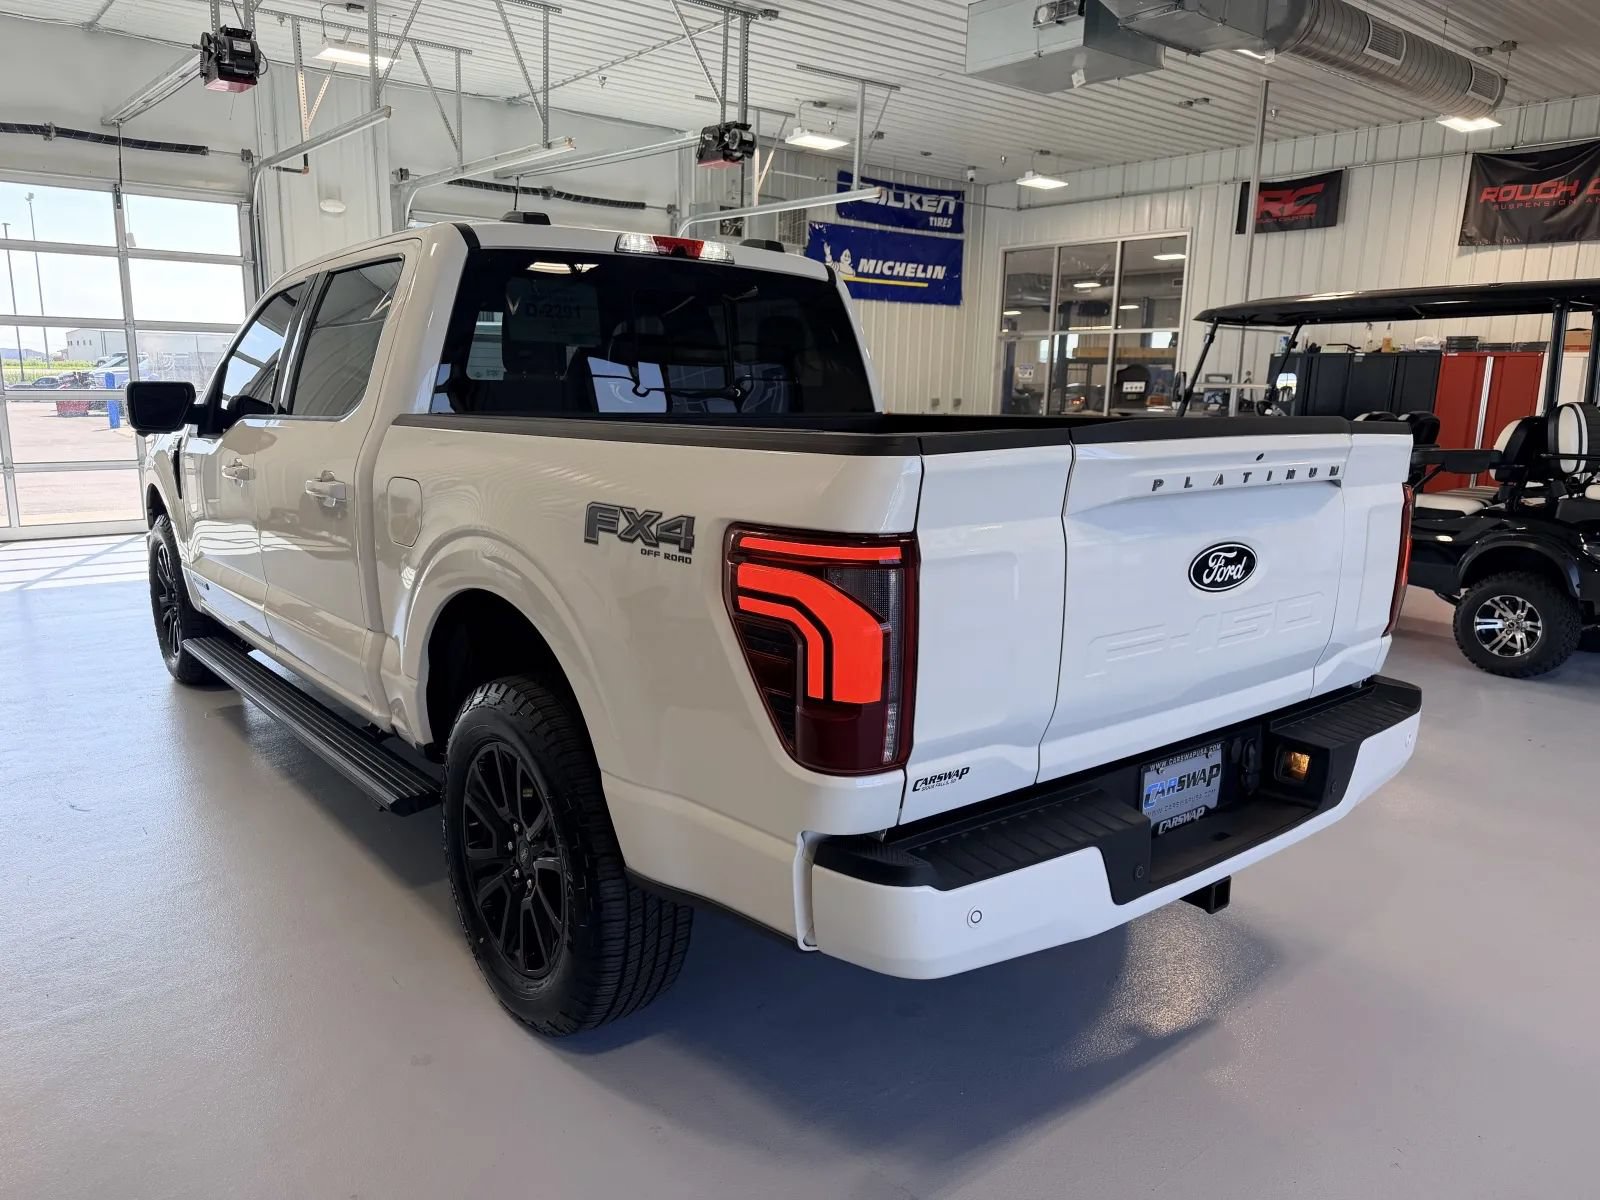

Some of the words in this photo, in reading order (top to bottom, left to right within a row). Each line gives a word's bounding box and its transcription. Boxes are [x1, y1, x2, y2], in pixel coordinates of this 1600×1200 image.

[1256, 183, 1325, 218] RC
[1479, 179, 1580, 203] ROUGH
[1493, 199, 1577, 210] SUSPENSION
[929, 216, 953, 228] TIRES
[858, 258, 947, 280] MICHELIN
[1151, 465, 1340, 492] PLATINUM
[584, 501, 695, 555] FX4
[640, 548, 661, 558] OFF
[663, 552, 692, 565] ROAD
[1202, 550, 1248, 585] Ford
[912, 766, 970, 792] CARSWAP
[1143, 763, 1221, 809] CARSWAP
[1158, 806, 1206, 835] CARSWAP
